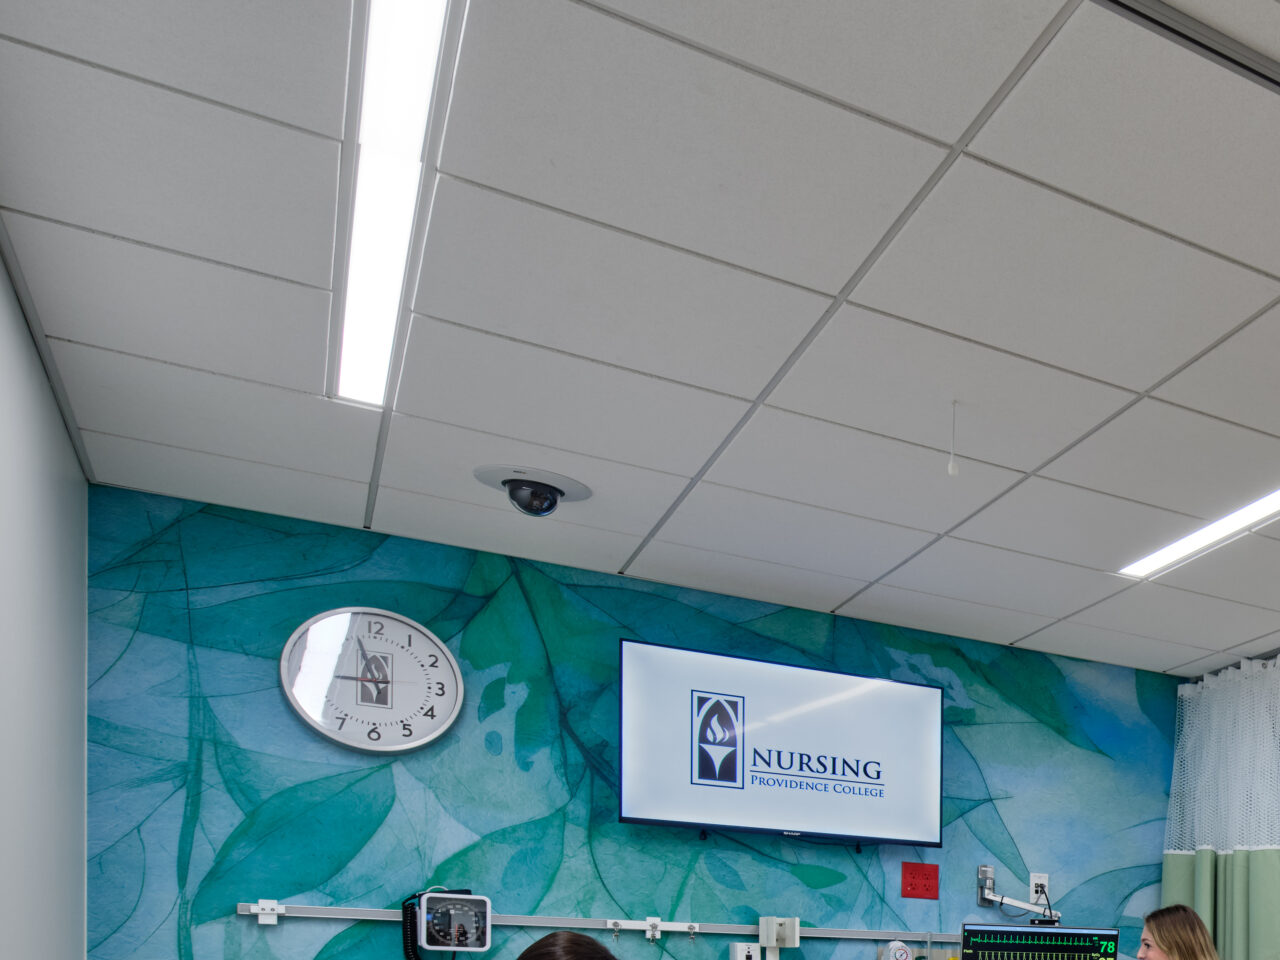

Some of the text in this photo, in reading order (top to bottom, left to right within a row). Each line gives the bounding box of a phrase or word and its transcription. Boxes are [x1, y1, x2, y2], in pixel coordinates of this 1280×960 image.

[368, 620, 385, 636] 12
[407, 634, 412, 648] 1
[428, 654, 439, 668] 2
[435, 682, 446, 696] 3
[423, 705, 437, 720] 4
[335, 716, 346, 731] 7
[402, 723, 413, 738] 5
[367, 726, 382, 741] 6
[751, 747, 882, 780] NURSING
[751, 774, 885, 798] PROVIDENCE COLLEGE
[1099, 941, 1116, 953] 78
